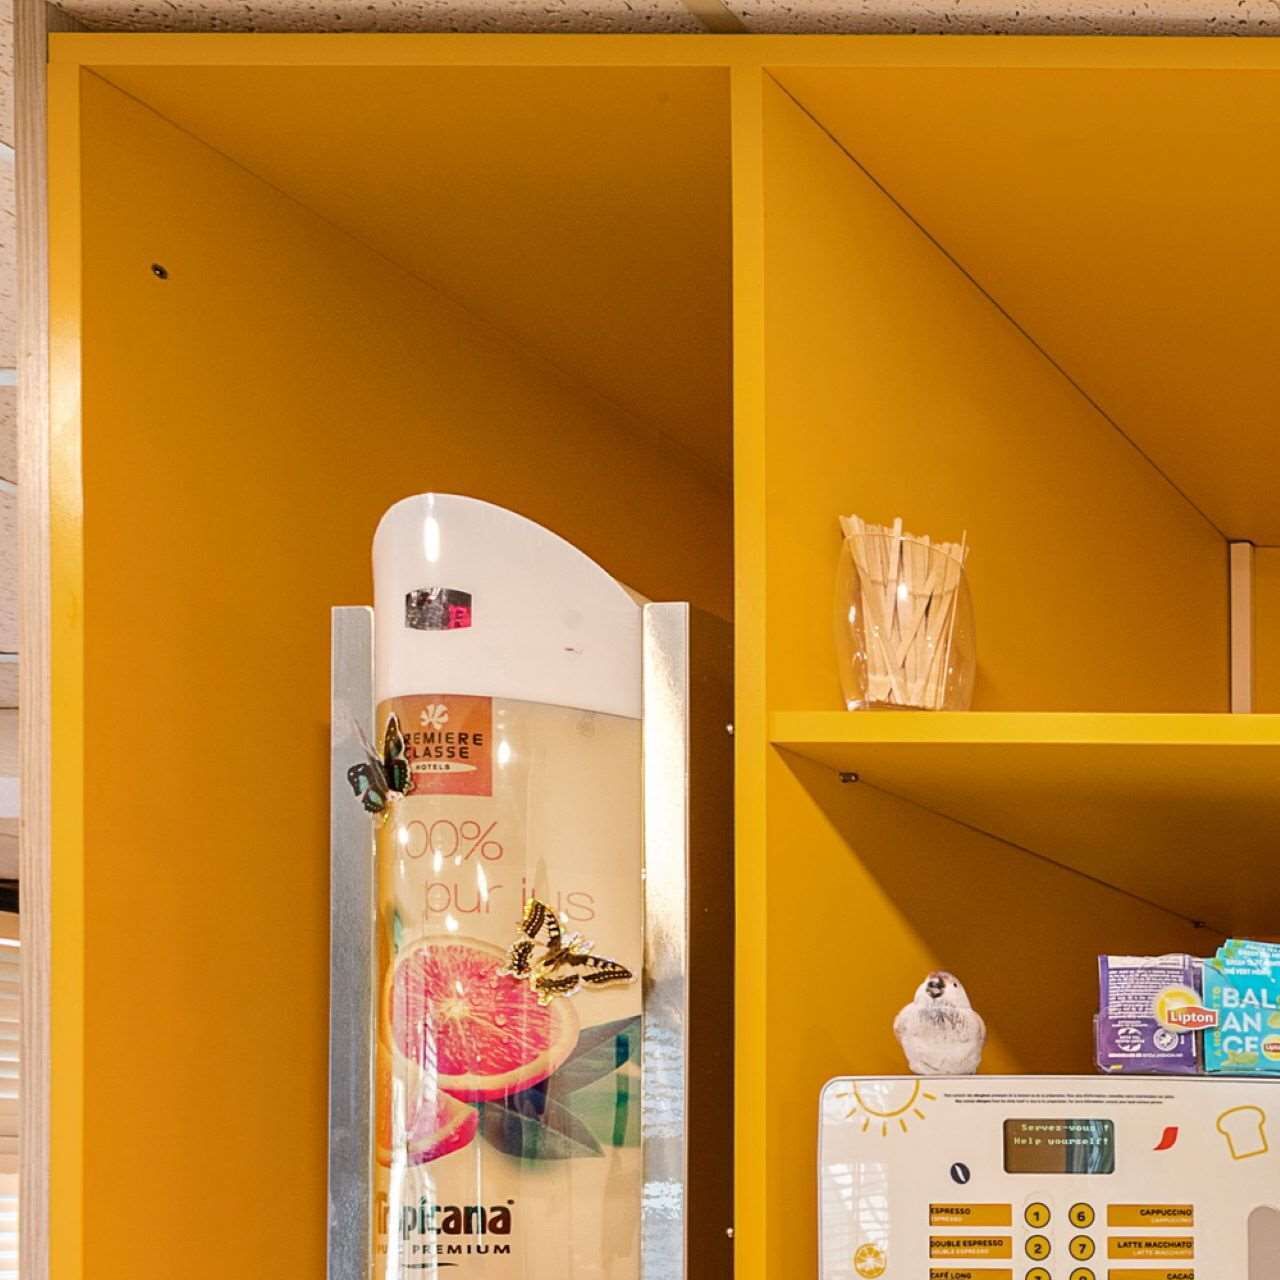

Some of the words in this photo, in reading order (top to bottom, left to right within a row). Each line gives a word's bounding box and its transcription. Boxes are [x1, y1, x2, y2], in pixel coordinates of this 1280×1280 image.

[403, 731, 484, 747] REMIERE
[405, 820, 504, 861] 00%
[423, 879, 504, 922] pur
[1221, 987, 1277, 1009] BAL
[1170, 1010, 1214, 1026] Lipton
[1220, 1011, 1262, 1032] AN
[1222, 1035, 1260, 1056] CE
[1021, 1124, 1096, 1133] Servez-vous
[1013, 1137, 1042, 1147] Help
[930, 1207, 972, 1216] ESPRESSO
[1033, 1211, 1040, 1221] 1
[1077, 1211, 1085, 1222] 6
[1139, 1209, 1192, 1217] CAPPUCCINO
[930, 1240, 961, 1248] DOUBLE
[962, 1239, 1004, 1247] ESPRESSO
[1034, 1243, 1042, 1254] 2
[1078, 1243, 1087, 1254] 7
[1117, 1241, 1143, 1249] LATTE
[1145, 1241, 1193, 1249] MACCHIATO
[412, 1244, 512, 1255] PREMIUM
[930, 1271, 948, 1280] CAFÉ
[951, 1272, 972, 1280] LONG
[1166, 1273, 1194, 1280] CACAO
